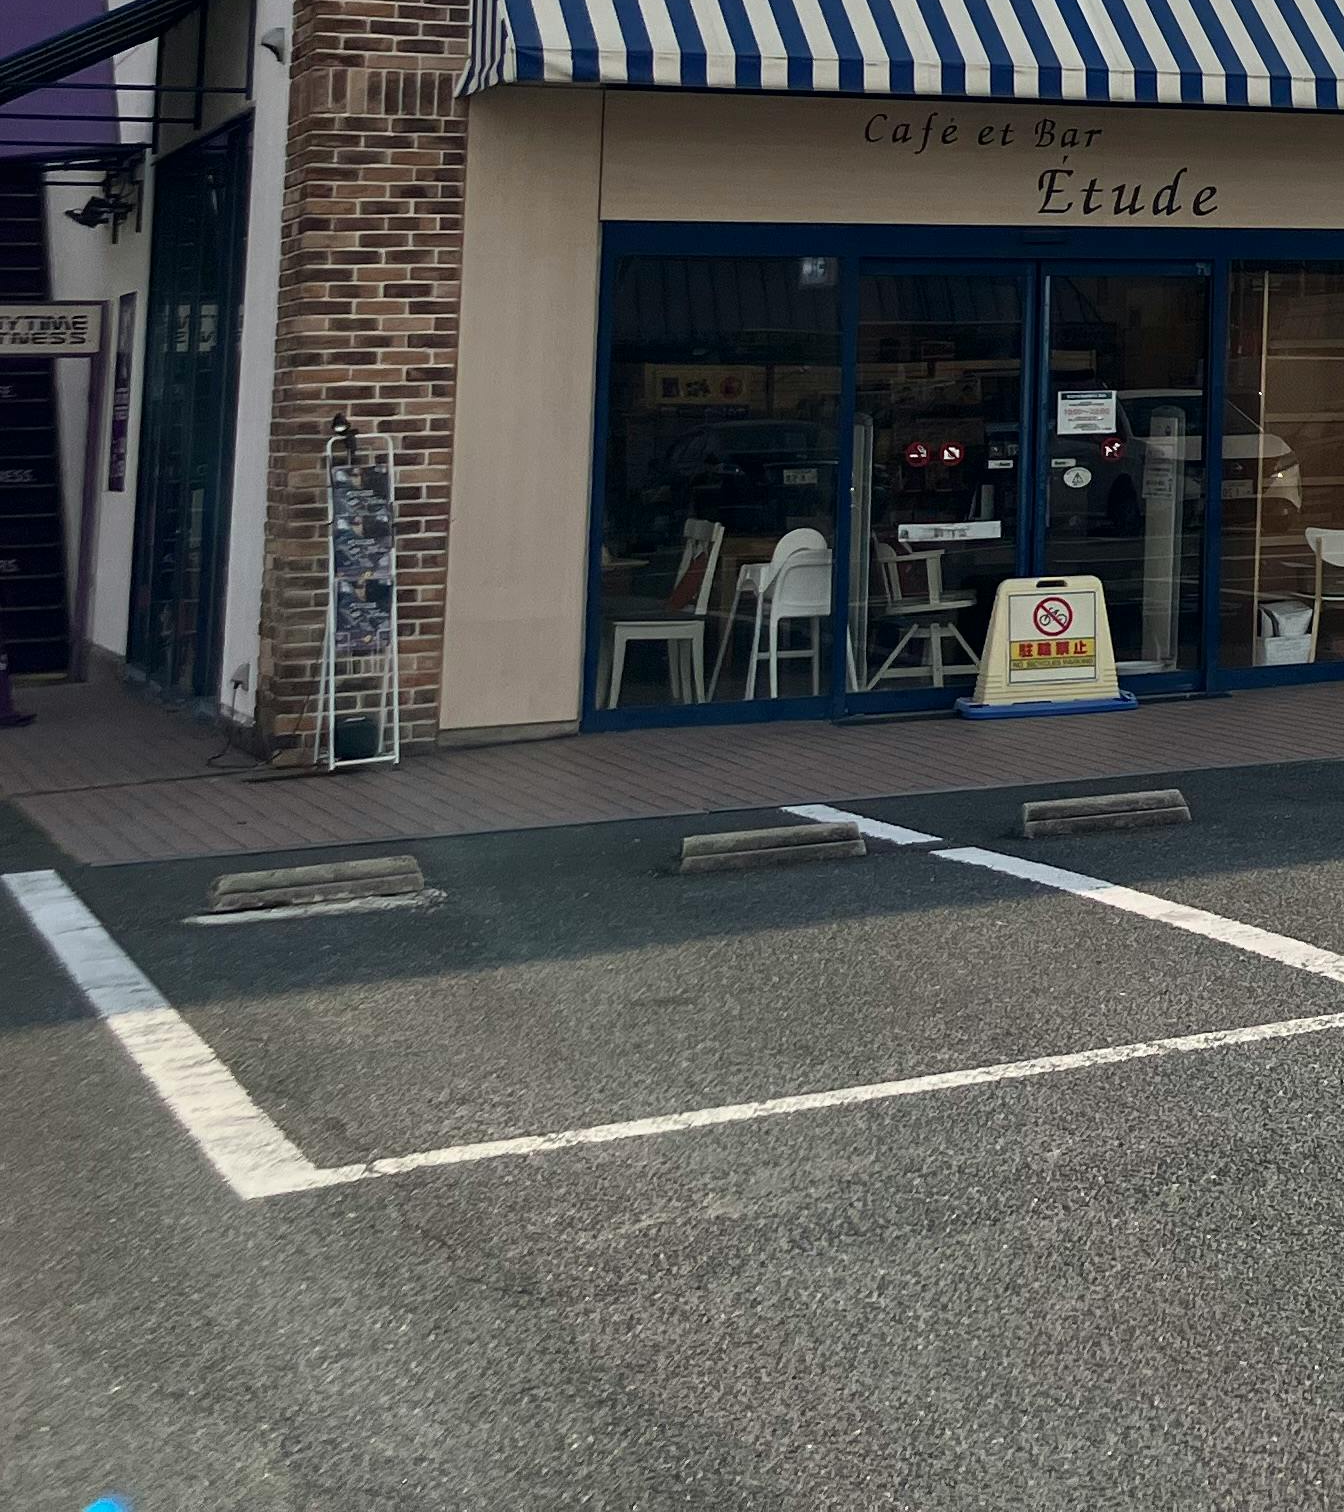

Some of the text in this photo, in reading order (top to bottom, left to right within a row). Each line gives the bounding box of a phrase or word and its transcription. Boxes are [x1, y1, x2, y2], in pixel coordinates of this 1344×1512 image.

[863, 112, 1103, 155] Café et Bar
[1037, 154, 1219, 218] Étude
